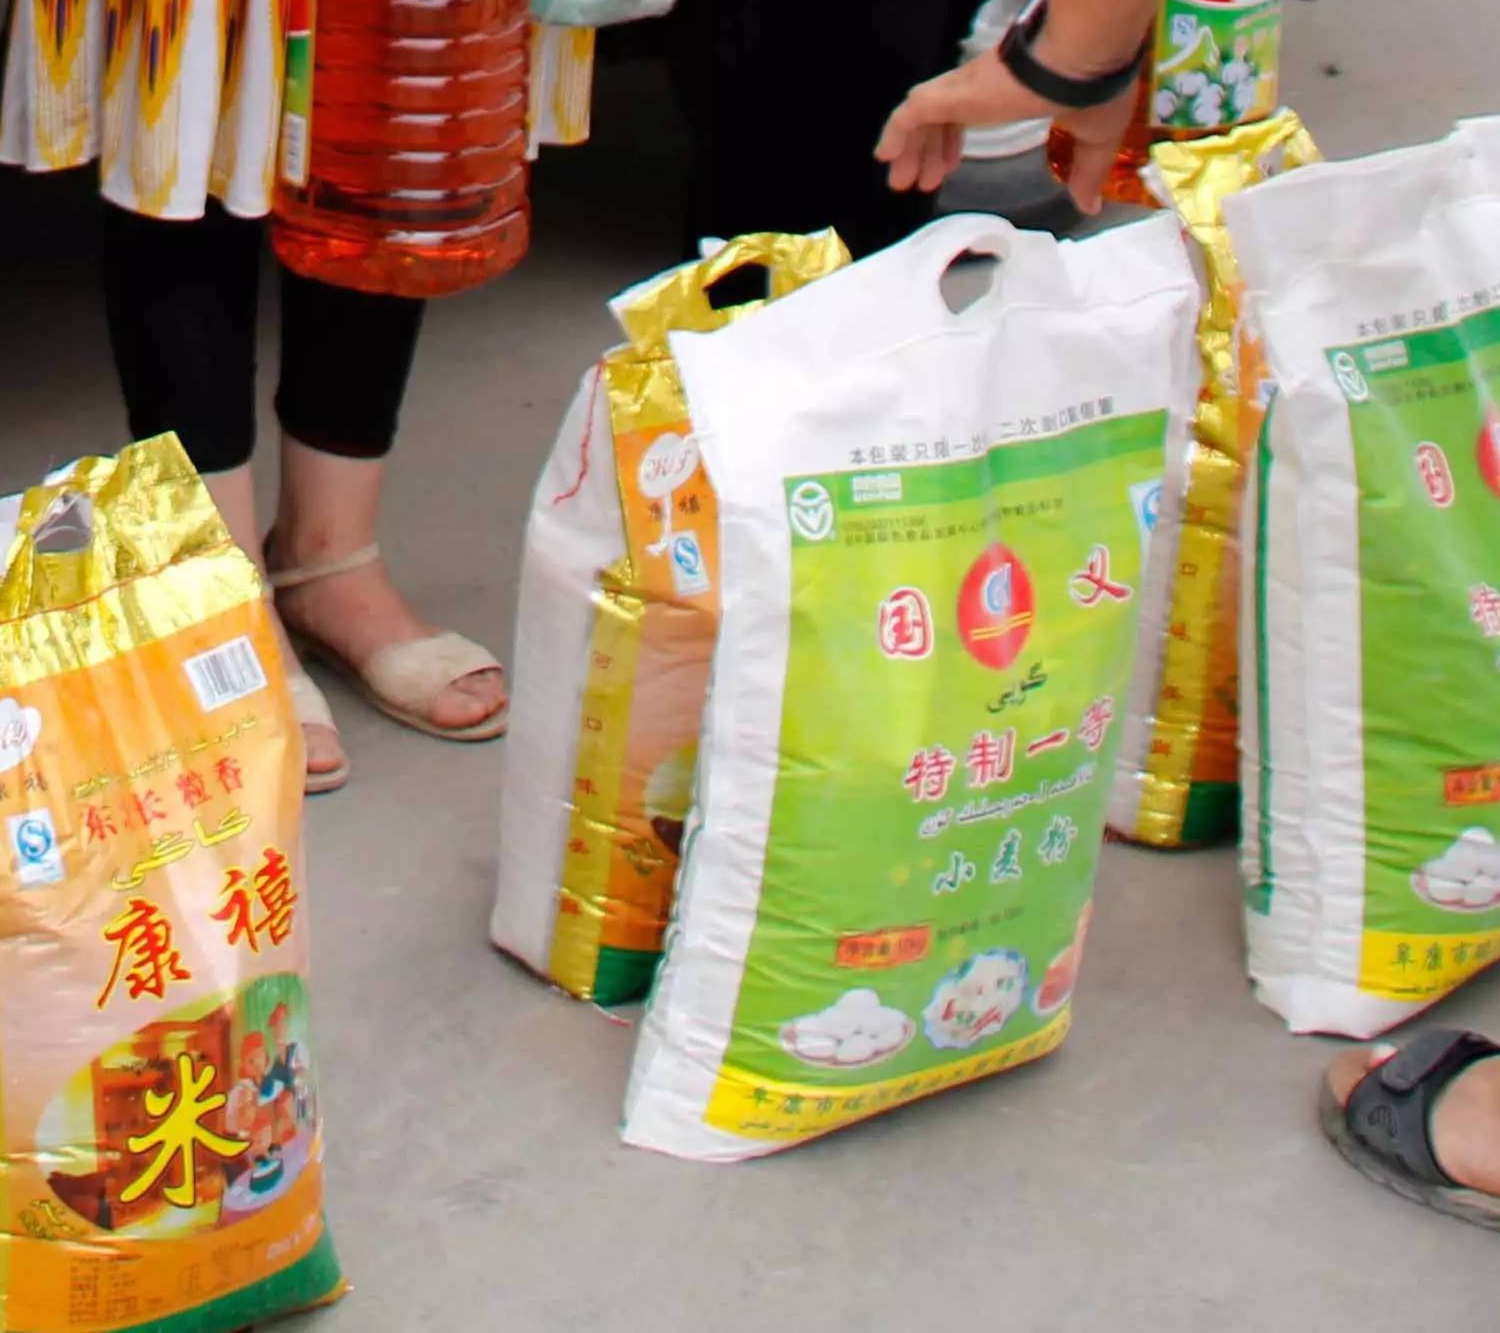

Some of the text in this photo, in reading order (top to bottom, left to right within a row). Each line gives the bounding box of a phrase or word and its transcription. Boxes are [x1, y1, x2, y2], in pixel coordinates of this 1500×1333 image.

[80, 755, 244, 842] 东长粒香
[905, 696, 1115, 802] 特制一等
[932, 814, 1079, 895] 小麦粉
[96, 846, 298, 1011] 康禧
[119, 1051, 252, 1208] 米
